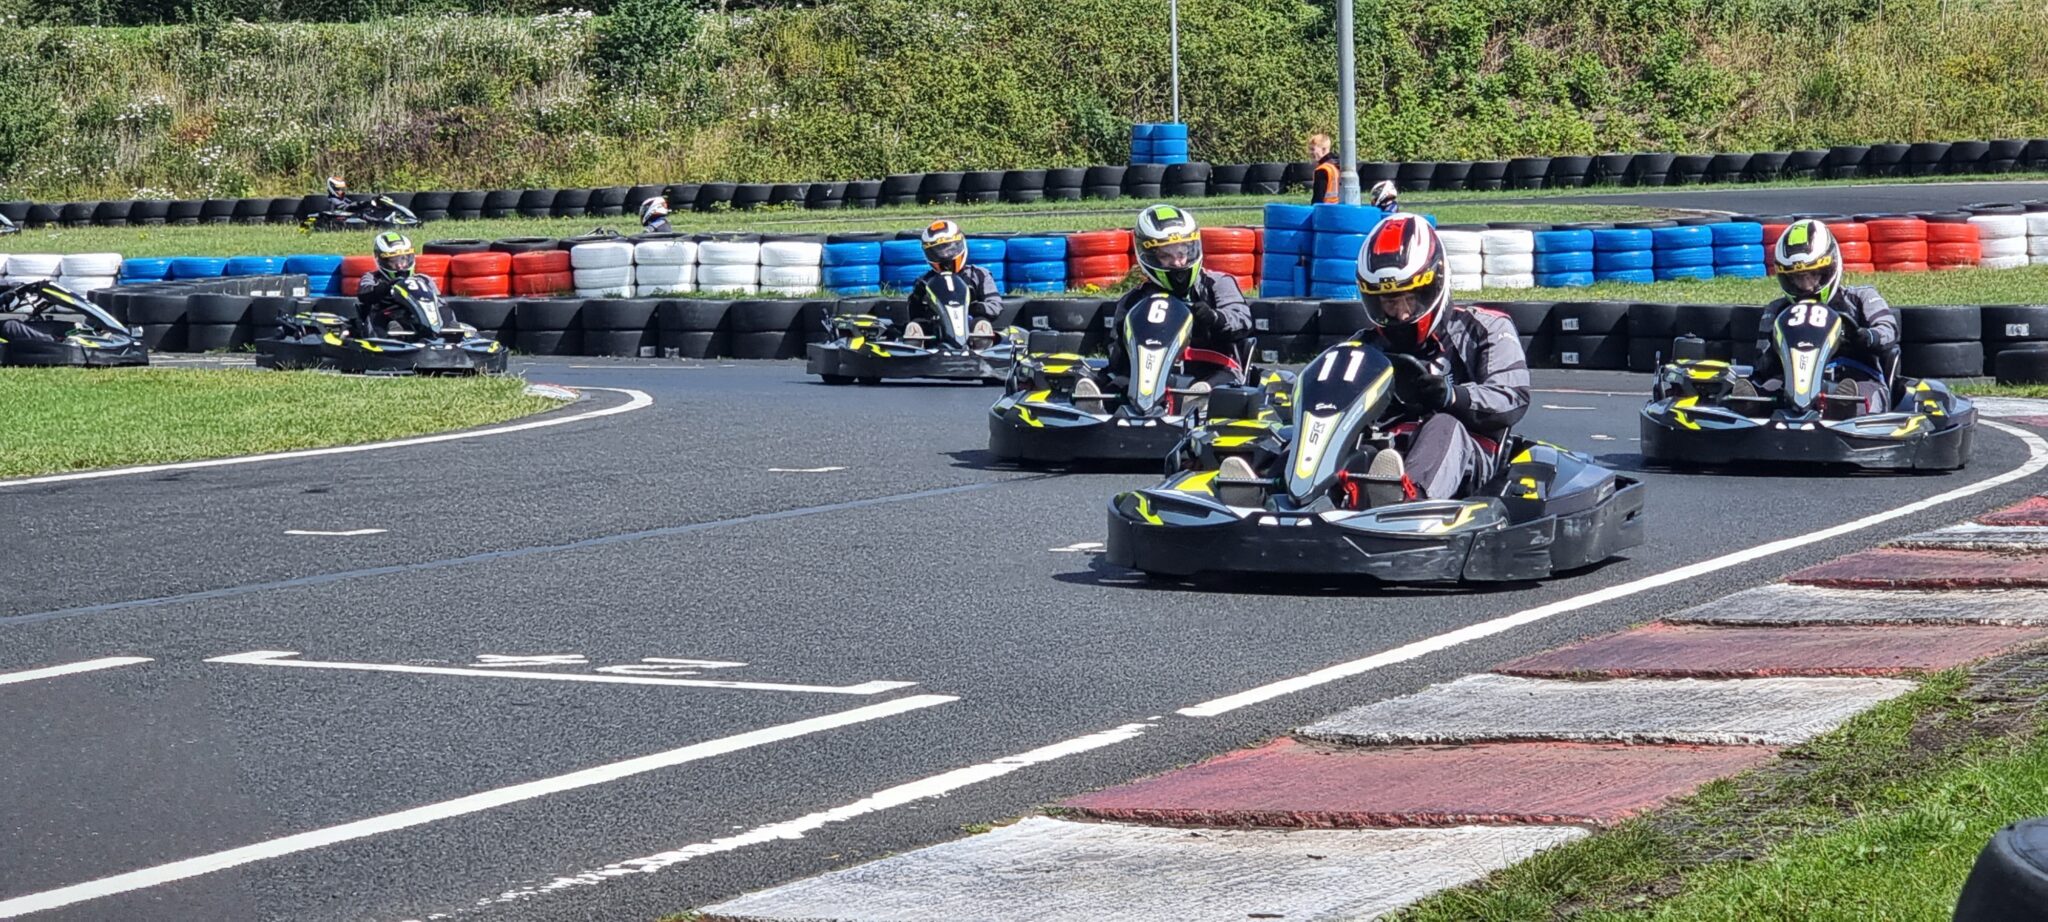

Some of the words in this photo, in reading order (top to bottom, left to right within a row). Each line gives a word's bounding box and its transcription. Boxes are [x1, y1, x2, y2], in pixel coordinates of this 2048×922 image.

[405, 279, 428, 292] 31
[944, 276, 954, 291] 1
[1147, 299, 1169, 324] 6
[1787, 304, 1828, 328] 38
[1317, 350, 1365, 382] 11
